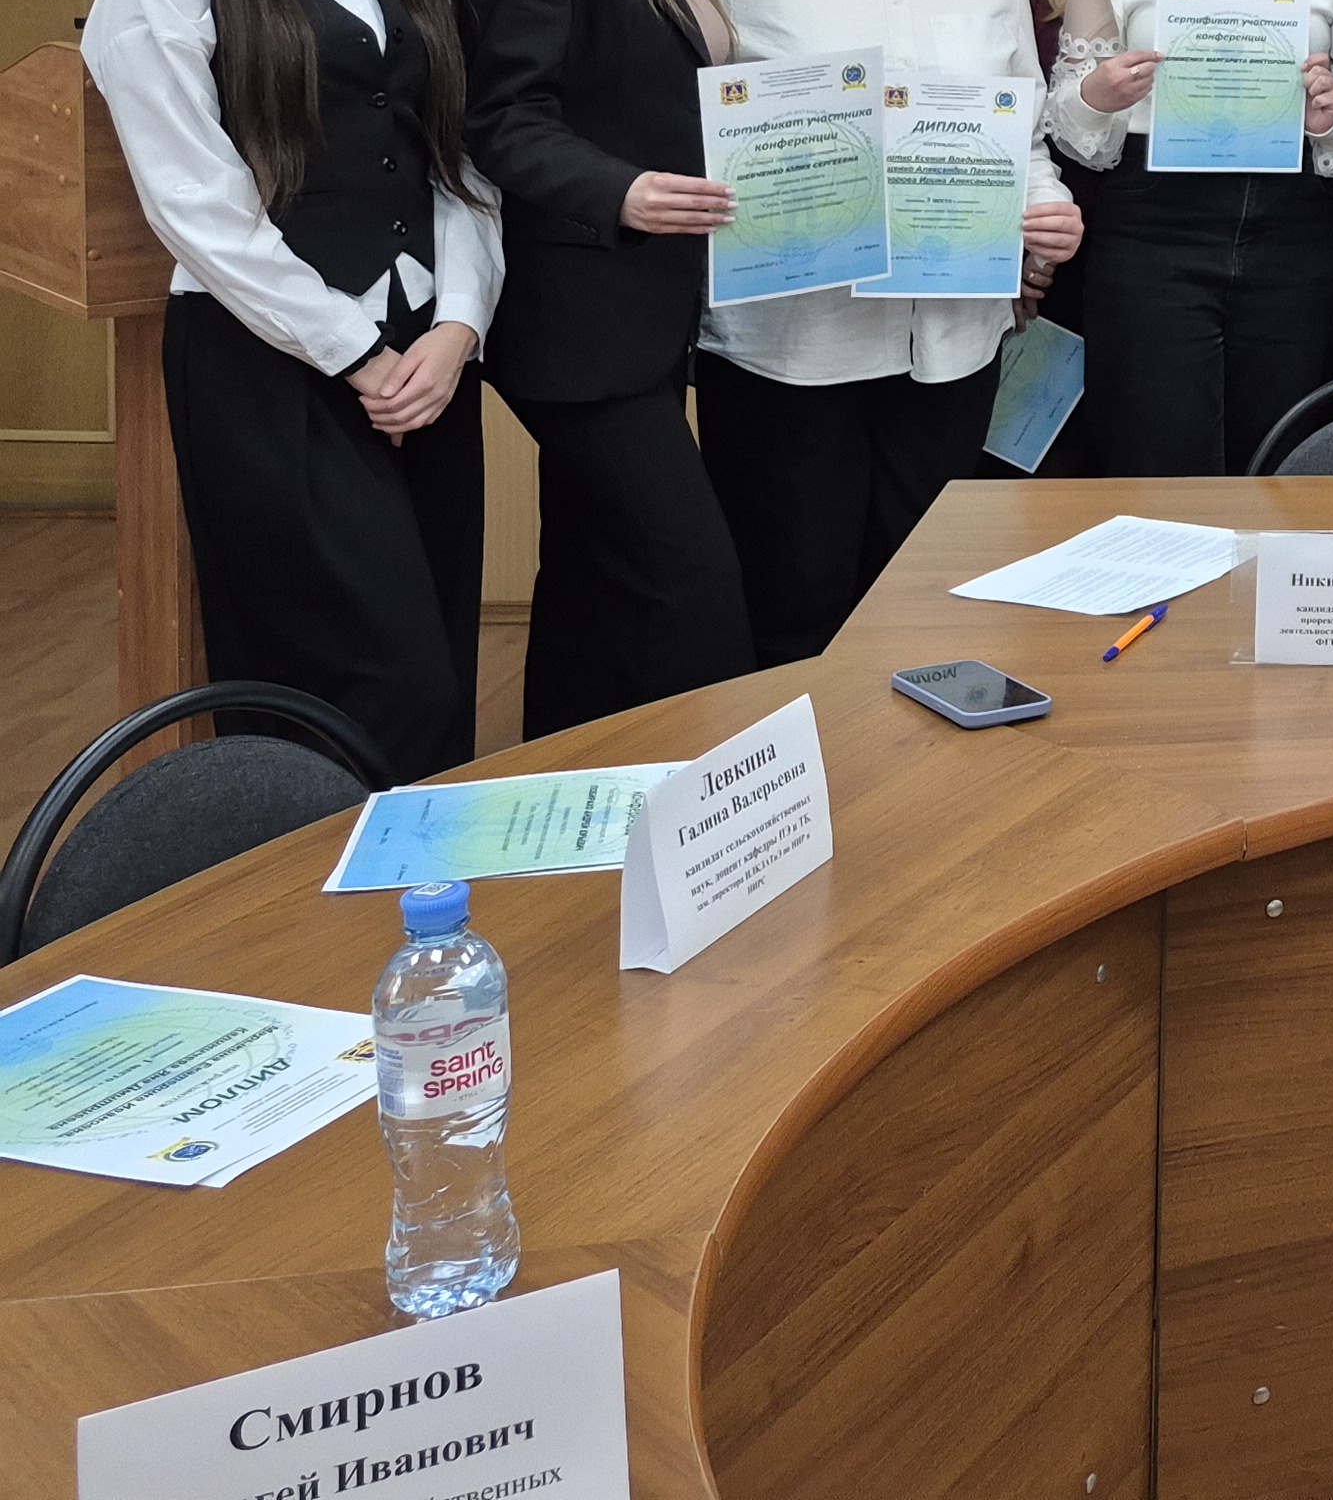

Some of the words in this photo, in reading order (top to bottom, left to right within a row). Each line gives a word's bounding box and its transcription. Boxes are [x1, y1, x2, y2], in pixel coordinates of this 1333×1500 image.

[1167, 14, 1239, 26] Сертификат
[1242, 18, 1298, 28] участника
[1196, 33, 1267, 43] конференции
[718, 117, 803, 138] Сертификат
[807, 108, 873, 127] участника
[754, 131, 839, 152] конференции
[912, 120, 981, 134] ДИПЛОМ
[700, 743, 777, 801] Левкина
[678, 809, 730, 847] Галина
[731, 761, 807, 816] Валерьевна
[685, 849, 724, 879] кандидат
[725, 795, 812, 854] сельскохозяйственных
[743, 836, 778, 863] кафедры
[173, 1057, 292, 1124] ДИПЛОМ
[423, 1056, 504, 1099] SPRING
[229, 1363, 484, 1451] Смирнов
[333, 1418, 536, 1495] Иванович
